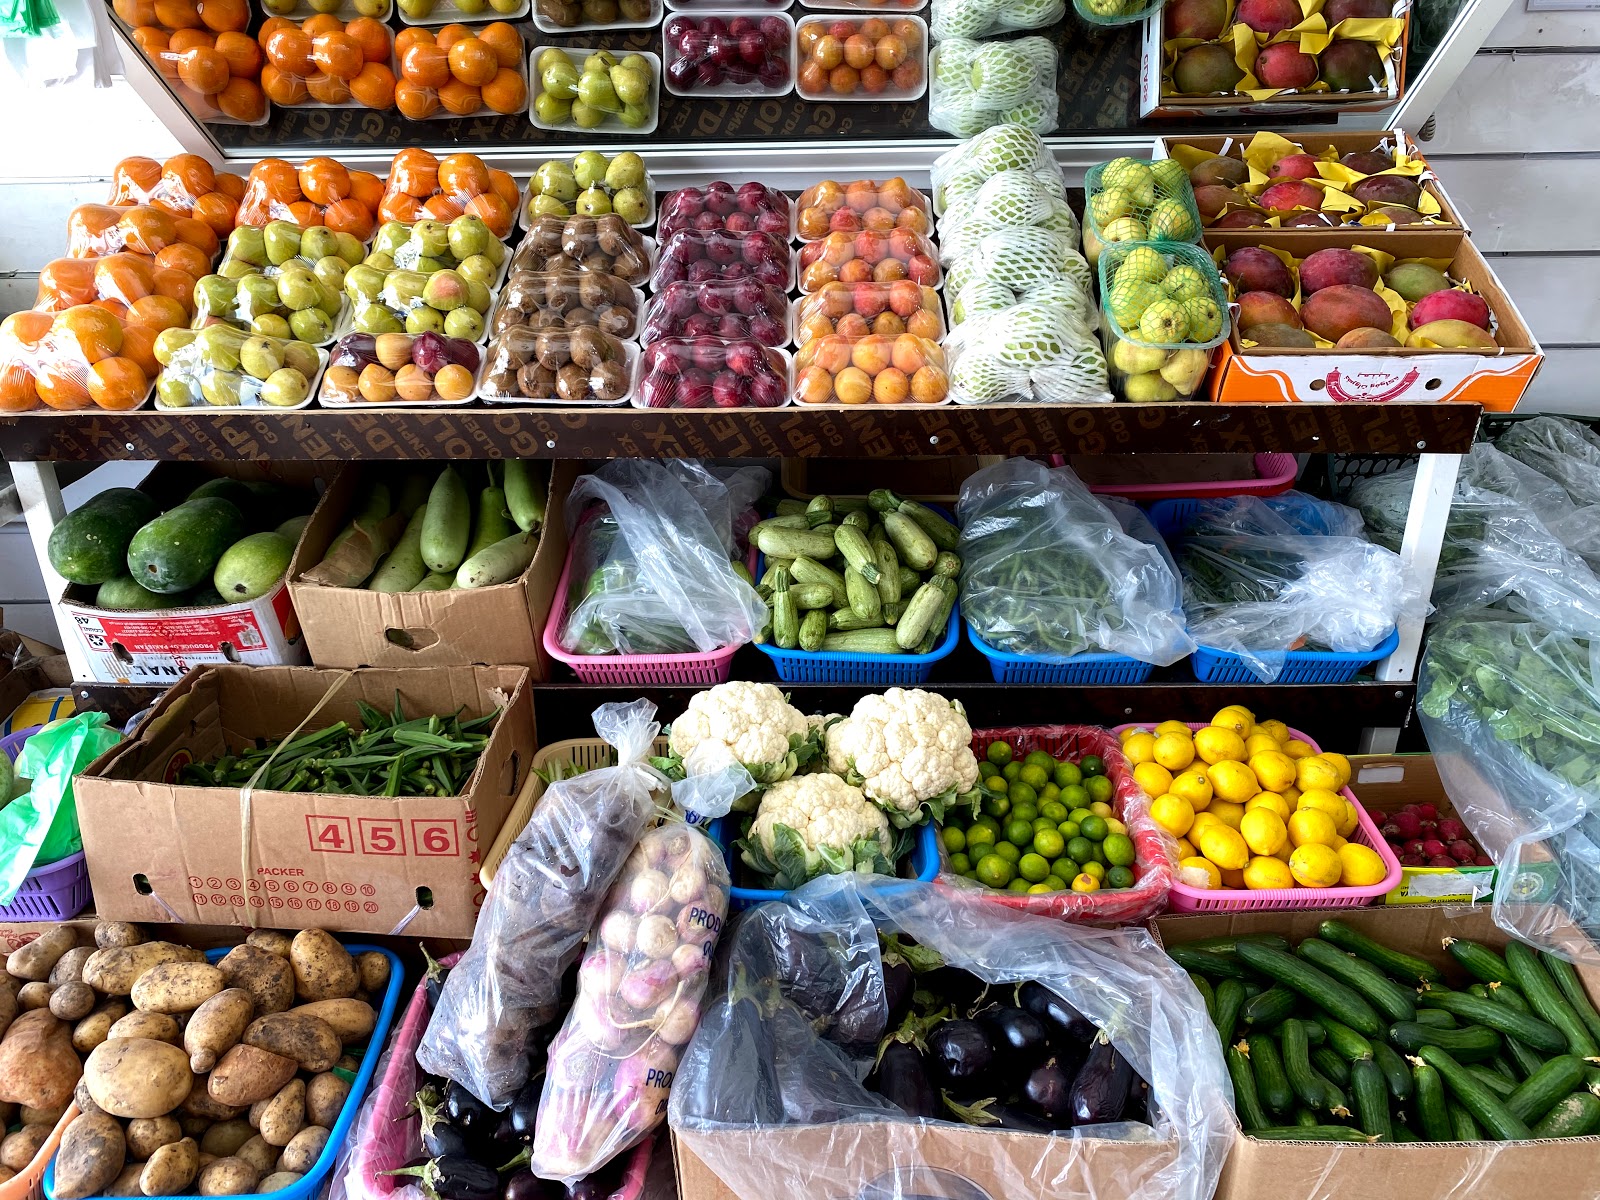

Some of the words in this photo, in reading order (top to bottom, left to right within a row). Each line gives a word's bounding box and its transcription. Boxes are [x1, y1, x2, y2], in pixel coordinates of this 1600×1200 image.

[75, 616, 88, 624] 48
[318, 824, 345, 849] 4
[370, 826, 396, 851] 5
[423, 827, 450, 852] 6
[257, 867, 305, 877] PACKER
